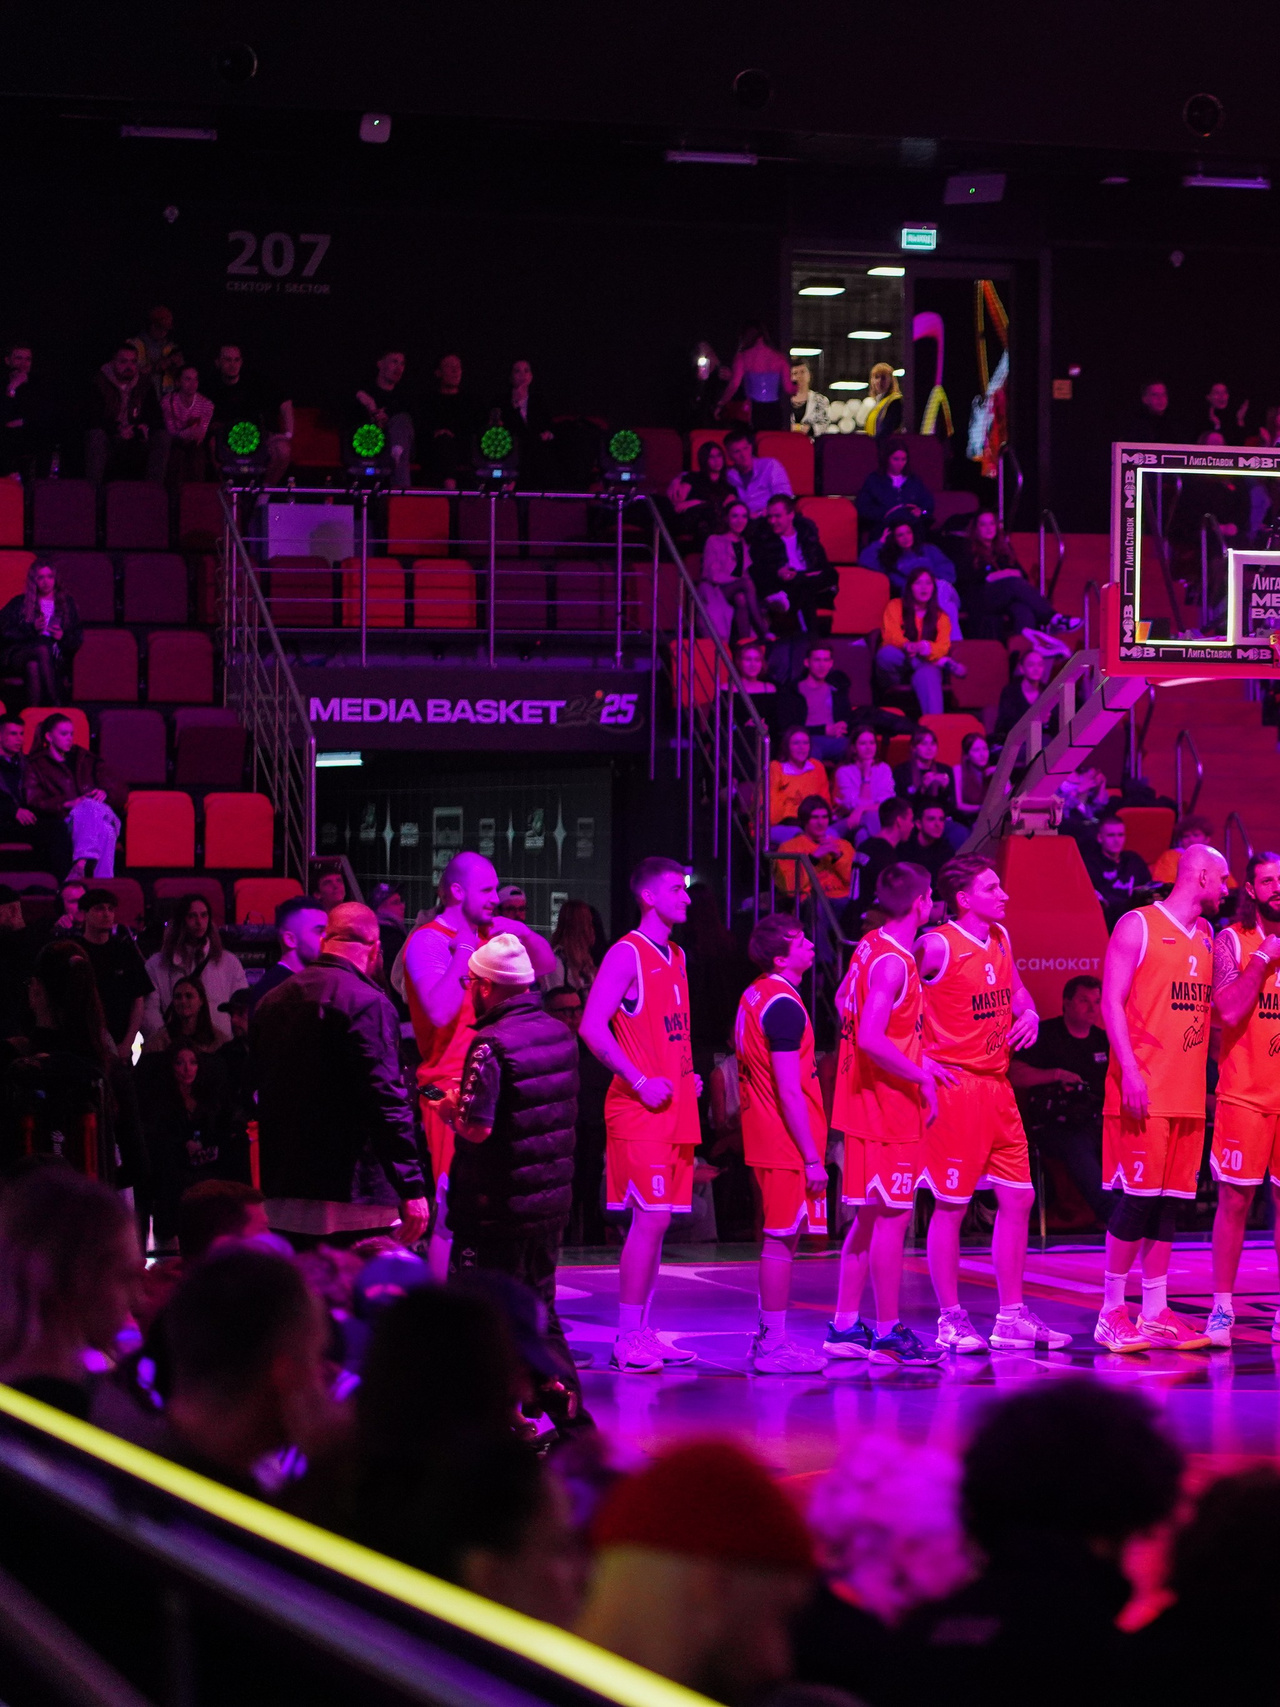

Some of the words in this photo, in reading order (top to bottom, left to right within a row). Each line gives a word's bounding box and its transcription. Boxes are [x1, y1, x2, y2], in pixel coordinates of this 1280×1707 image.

[226, 229, 332, 278] 207
[309, 696, 423, 724] MEDIA
[426, 698, 567, 725] BASKET
[984, 962, 997, 986] 3
[1188, 955, 1198, 977] 2
[971, 987, 1011, 1012] MASTER
[1171, 981, 1212, 1004] MASTER
[1221, 1147, 1243, 1171] 20
[890, 1172, 913, 1195] 25
[945, 1167, 960, 1190] 3
[1133, 1160, 1145, 1183] 2
[651, 1174, 665, 1198] 9
